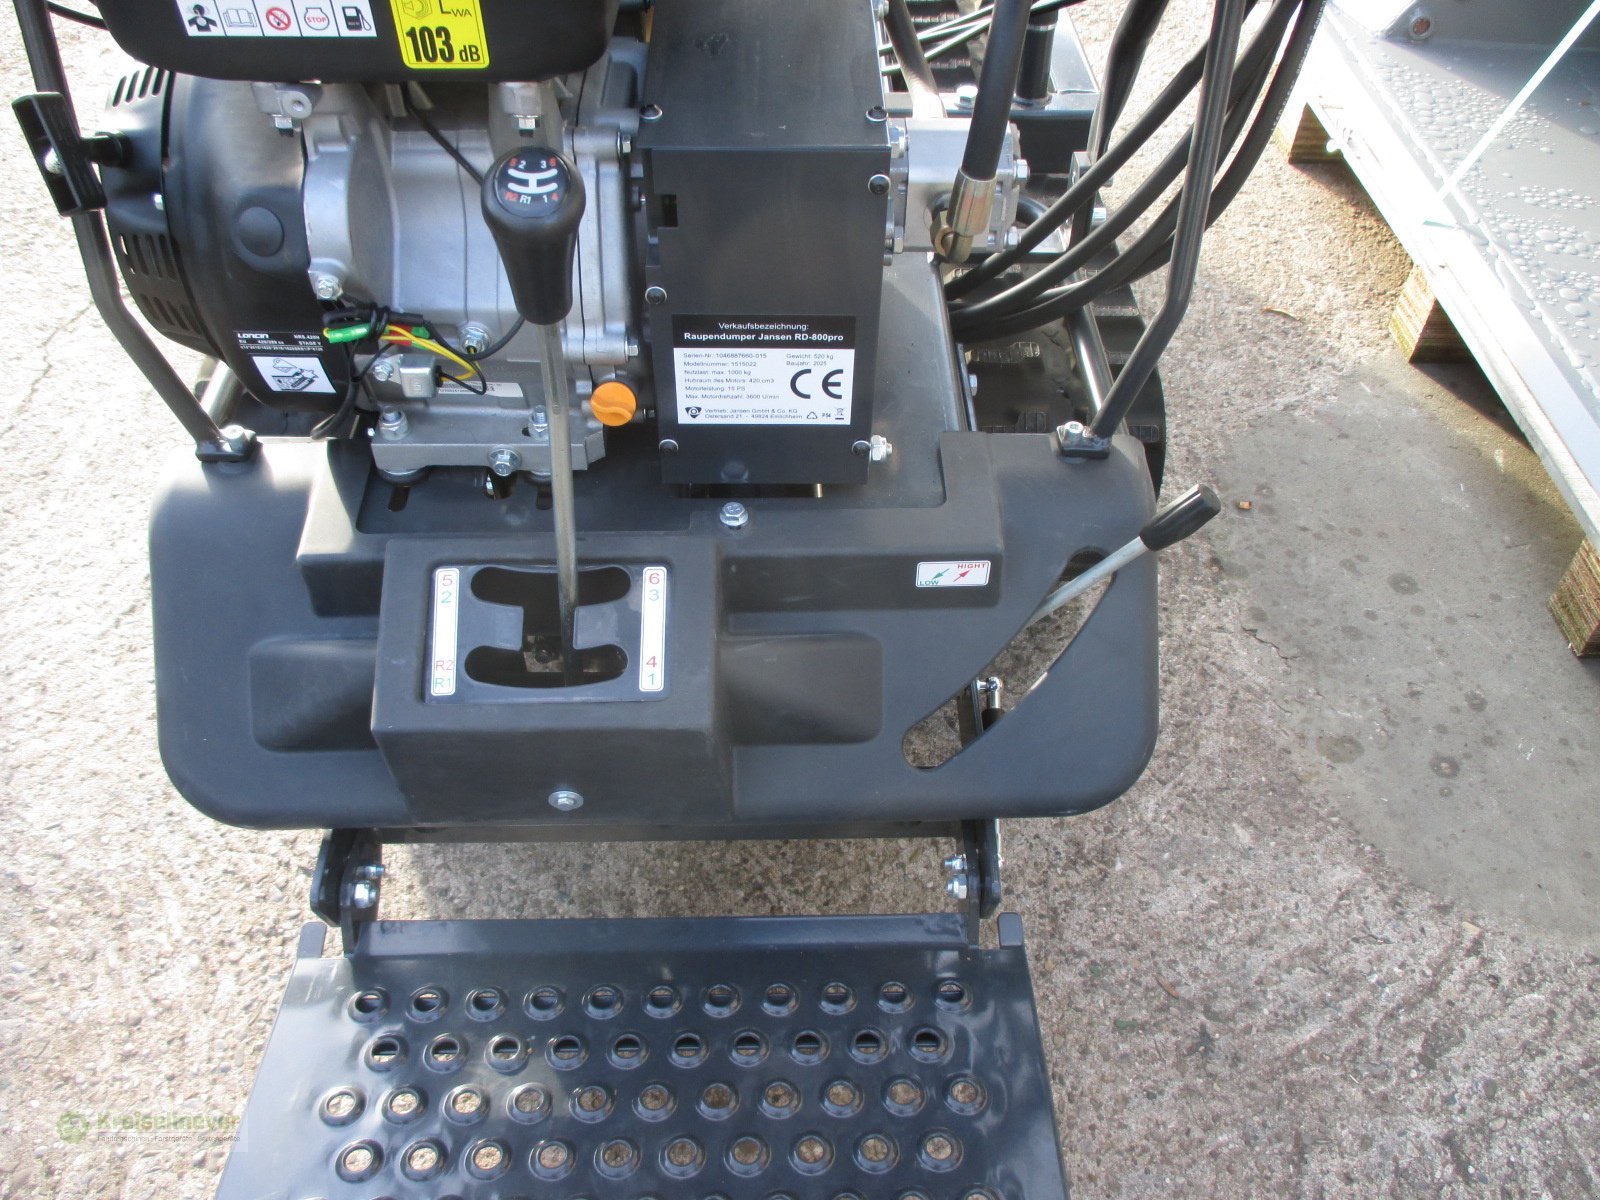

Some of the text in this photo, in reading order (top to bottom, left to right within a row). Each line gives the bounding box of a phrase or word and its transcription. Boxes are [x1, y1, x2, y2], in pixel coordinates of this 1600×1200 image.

[406, 26, 481, 62] 103 dB
[518, 160, 527, 169] 2
[540, 160, 547, 169] 3
[520, 194, 532, 205] R1
[542, 194, 548, 203] 1
[718, 322, 809, 331] Verkaufsbezeichnung:
[684, 332, 844, 342] Raupendumper Jansen RD-800pro
[789, 368, 844, 400] CE
[441, 574, 454, 587] 5
[648, 572, 661, 585] 6
[440, 591, 453, 604] 2
[648, 588, 660, 602] 3
[435, 660, 454, 672] R2
[645, 655, 658, 669] 4
[435, 677, 452, 689] R1
[647, 673, 655, 686] 1
